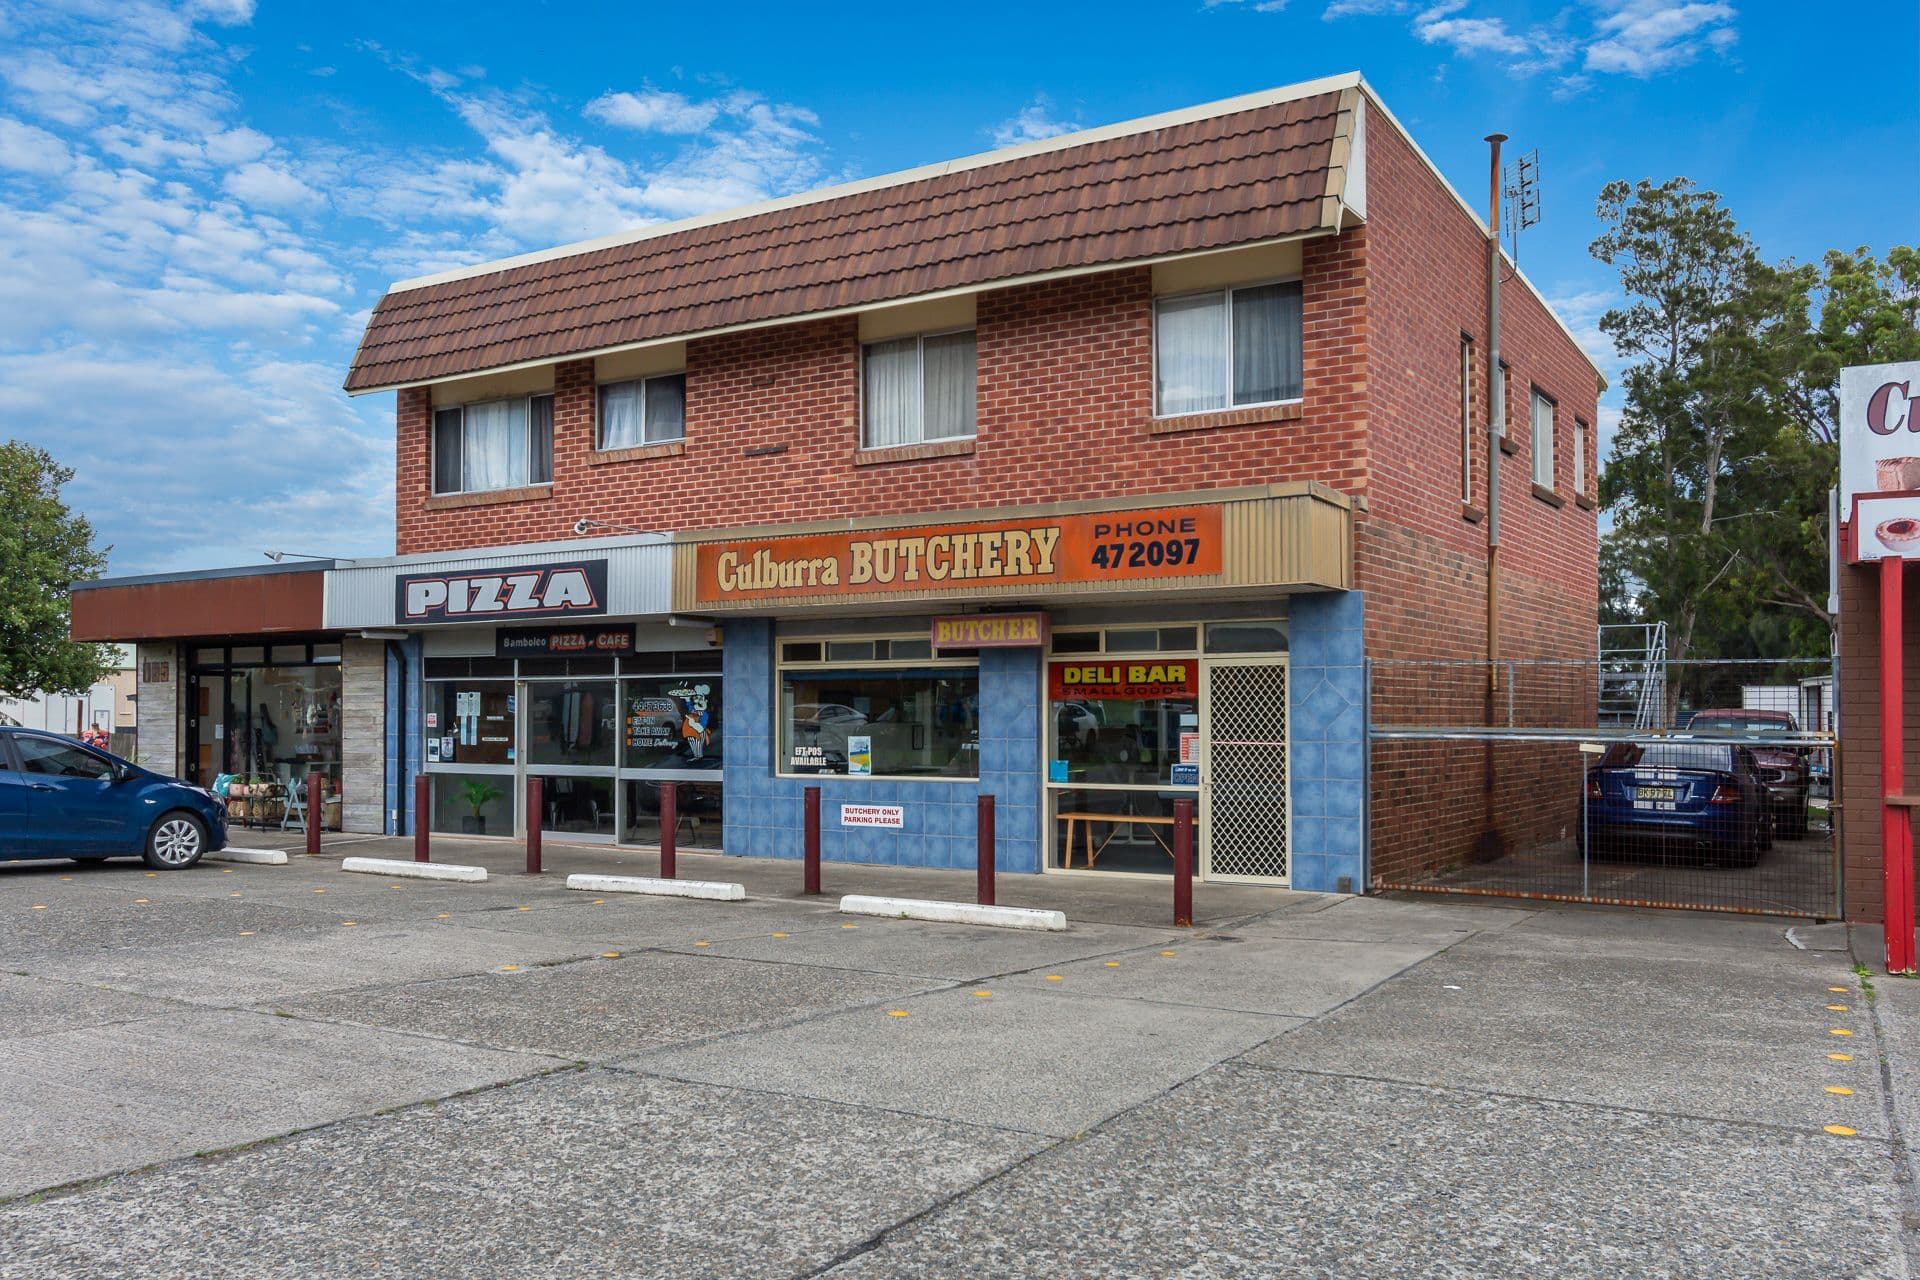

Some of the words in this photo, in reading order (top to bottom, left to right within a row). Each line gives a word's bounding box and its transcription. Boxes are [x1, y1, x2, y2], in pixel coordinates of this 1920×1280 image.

[1093, 517, 1197, 539] PHONE
[717, 549, 839, 592] Culburra
[849, 526, 1060, 585] BUTCHERY
[1091, 538, 1200, 570] 472097
[406, 570, 596, 616] PIZZA
[937, 618, 1039, 642] BUTCHER
[551, 634, 585, 648] PIZZA
[597, 634, 629, 647] CAFE
[1063, 666, 1121, 685] DELI
[1127, 665, 1187, 684] BAR
[1062, 686, 1187, 696] SMALLGOODS
[790, 757, 827, 766] AVAILABLE
[844, 816, 873, 824] PARKING
[874, 817, 900, 825] PLEASE
[845, 807, 880, 815] BUTCHERY
[882, 808, 899, 816] ONLY
